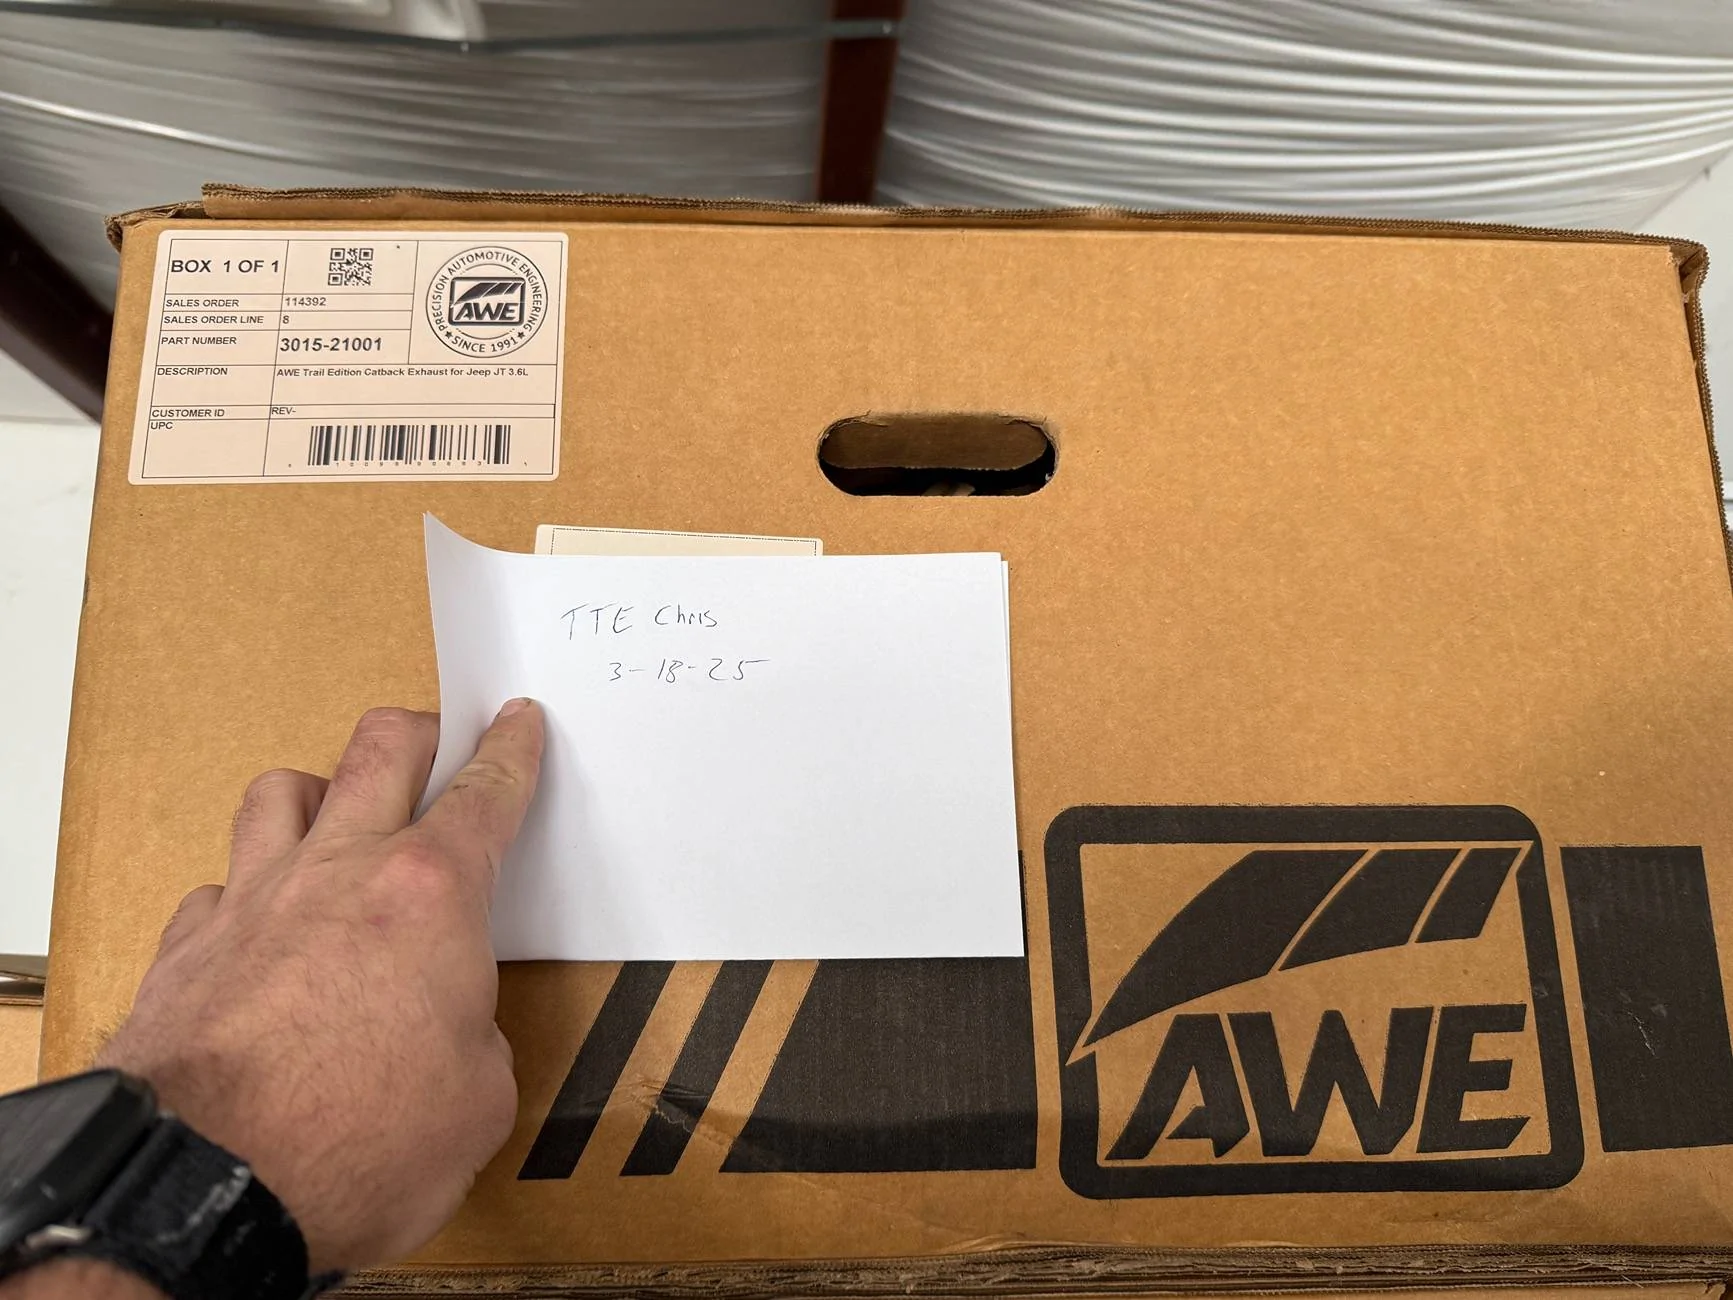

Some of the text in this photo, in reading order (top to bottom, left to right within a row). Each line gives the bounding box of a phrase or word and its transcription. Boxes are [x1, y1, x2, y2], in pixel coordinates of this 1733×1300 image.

[171, 260, 279, 273] BOX 1 OF 1
[432, 251, 542, 332] PRECISION AUTOMOTIVE ENGINEERING
[165, 299, 240, 308] SALES ORDER
[285, 297, 327, 307] 114392
[454, 302, 520, 321] AWE
[163, 315, 264, 324] SALES ORDER LINE
[282, 315, 290, 325] 8
[161, 336, 237, 345] PART NUMBER
[280, 337, 383, 352] 3015-21001
[451, 336, 519, 353] SINCE 1991
[157, 367, 228, 376] DESCRIPTION
[276, 367, 529, 378] AWE Trail Edition Catback Exhaust for Jeep JT 3.6L
[152, 408, 225, 418] CUSTOMER ID
[271, 406, 297, 415] REV-
[150, 421, 173, 430] UPC
[560, 602, 718, 641] TTE Chris
[1104, 1003, 1531, 1160] AWE
